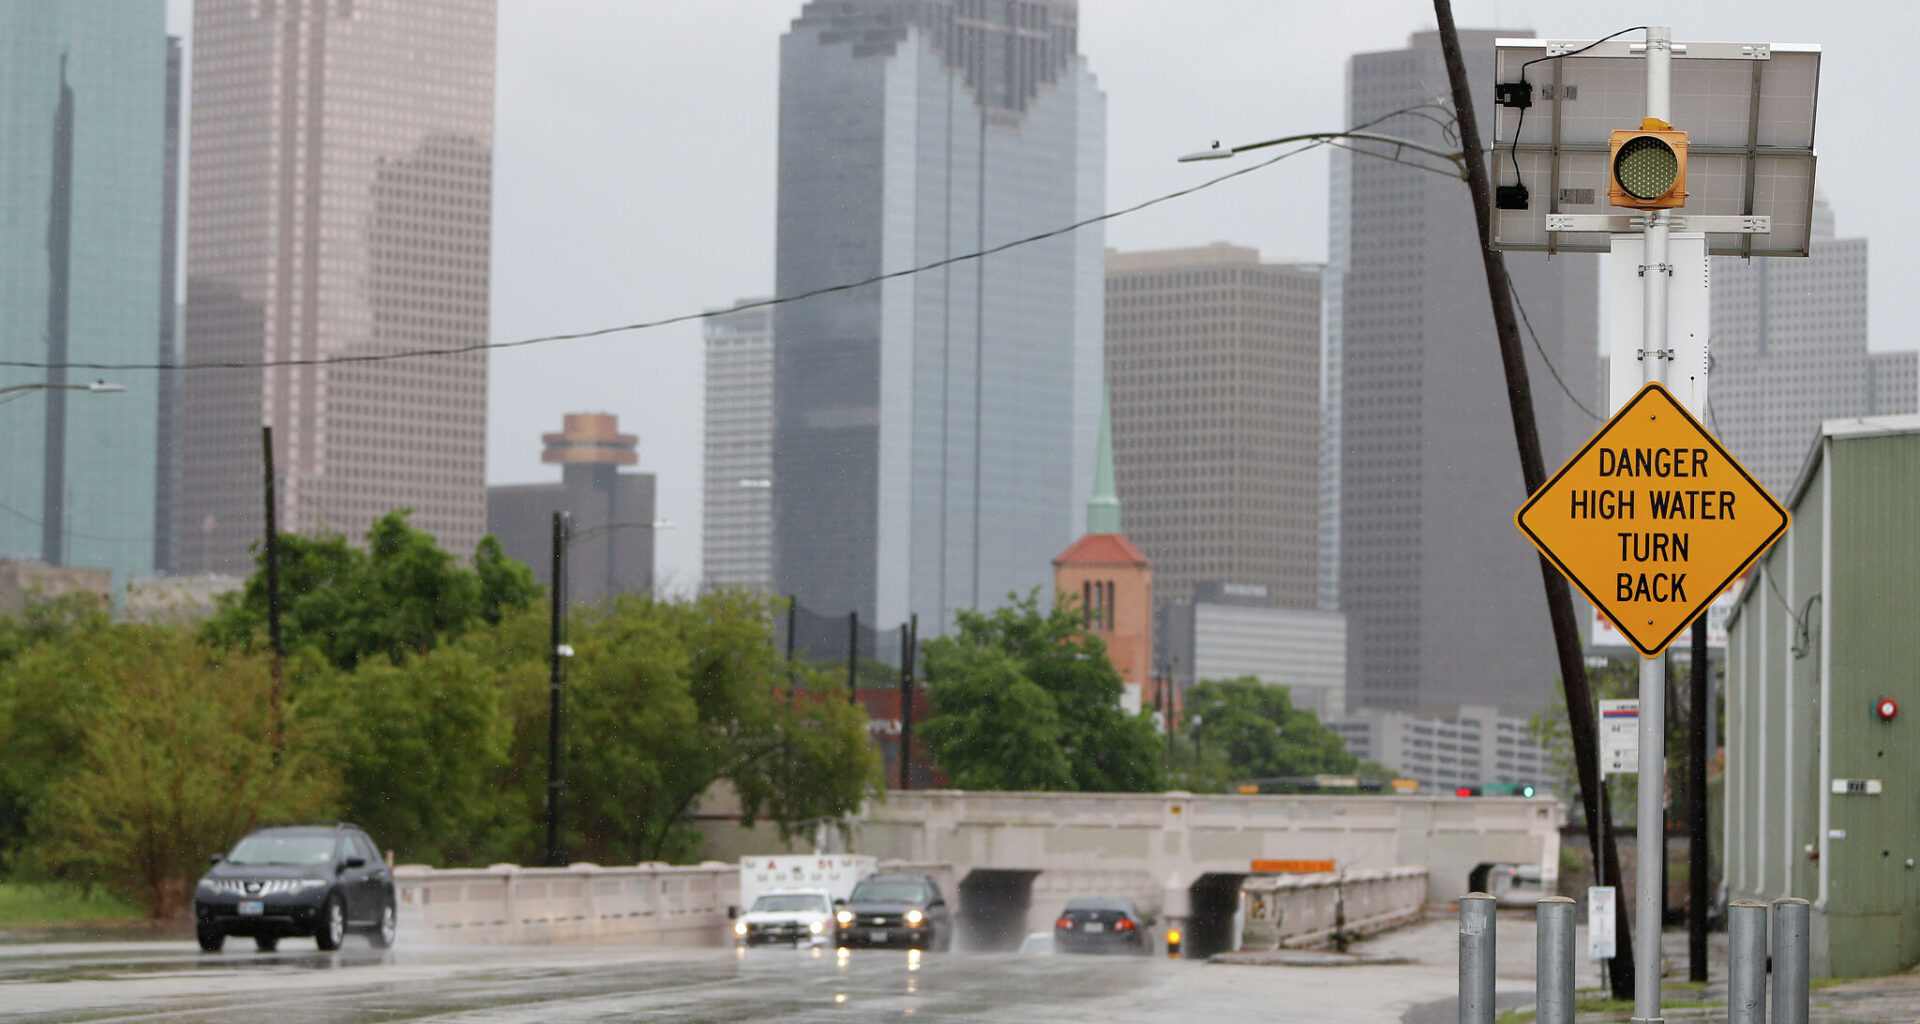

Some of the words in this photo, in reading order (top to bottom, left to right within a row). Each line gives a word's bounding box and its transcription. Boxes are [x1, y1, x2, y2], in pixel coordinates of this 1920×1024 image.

[1599, 448, 1708, 477] DANGER
[1571, 490, 1634, 519] HIGH
[1649, 490, 1736, 520] WATER
[1617, 533, 1689, 562] TURN
[1616, 573, 1687, 602] BACK
[767, 859, 776, 870] A
